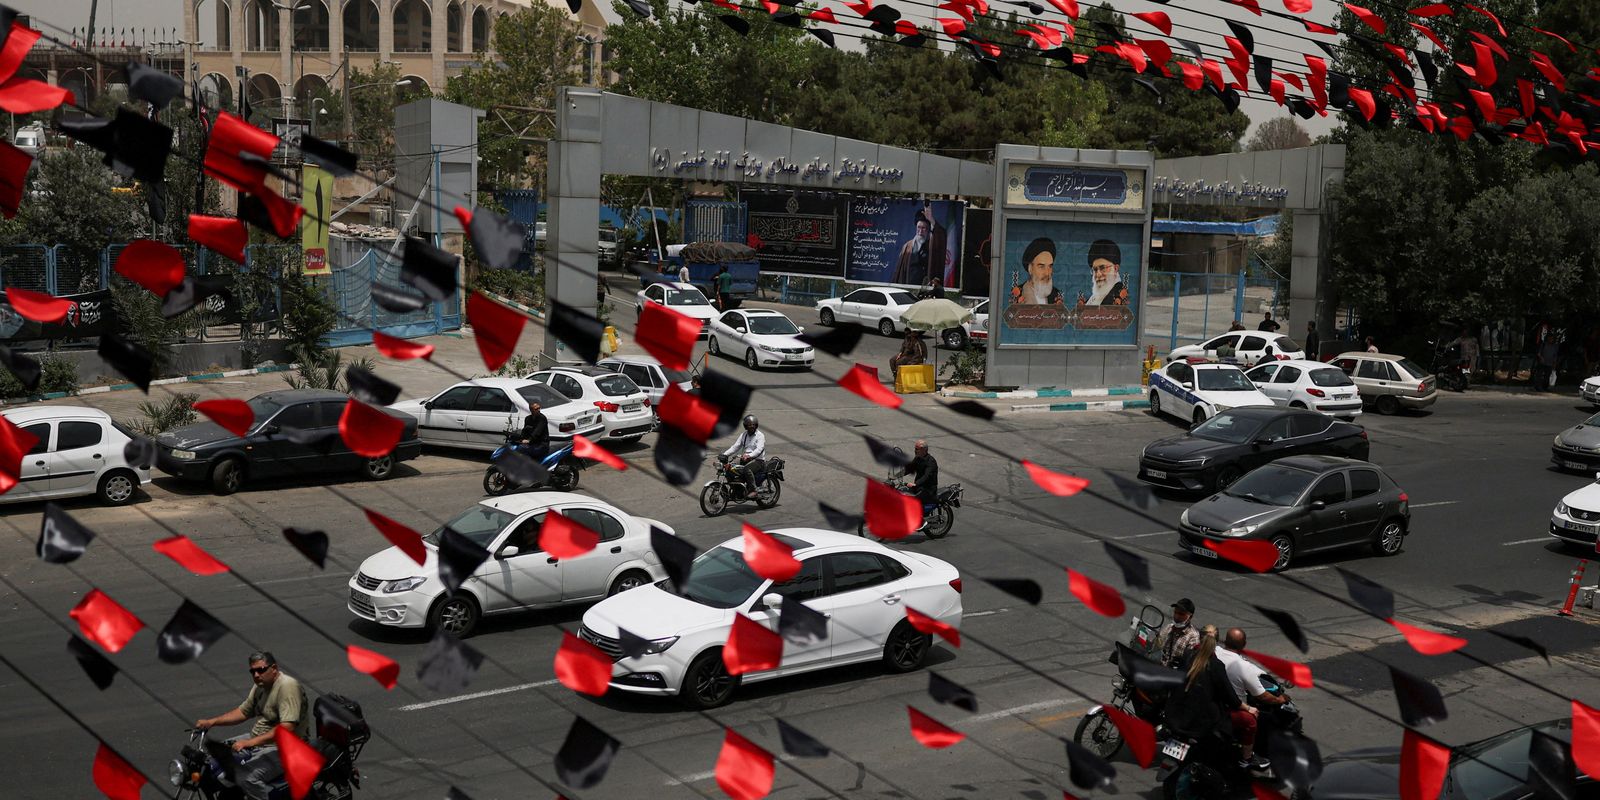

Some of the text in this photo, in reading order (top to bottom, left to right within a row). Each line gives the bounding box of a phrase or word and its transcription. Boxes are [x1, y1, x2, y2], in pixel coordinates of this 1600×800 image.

[674, 150, 707, 174] خمینی
[711, 150, 730, 169] امام
[734, 151, 763, 177] بزرگ
[766, 156, 800, 178] مصلای
[802, 156, 831, 180] عبادی
[834, 157, 868, 183] فرهنگی
[869, 165, 904, 184] مجموعه
[1168, 178, 1191, 197] بزرگ
[1190, 179, 1214, 196] مصلای
[1213, 180, 1236, 199] عبادی
[1235, 180, 1263, 201] فرهنگی
[1261, 185, 1289, 201] مجموعه
